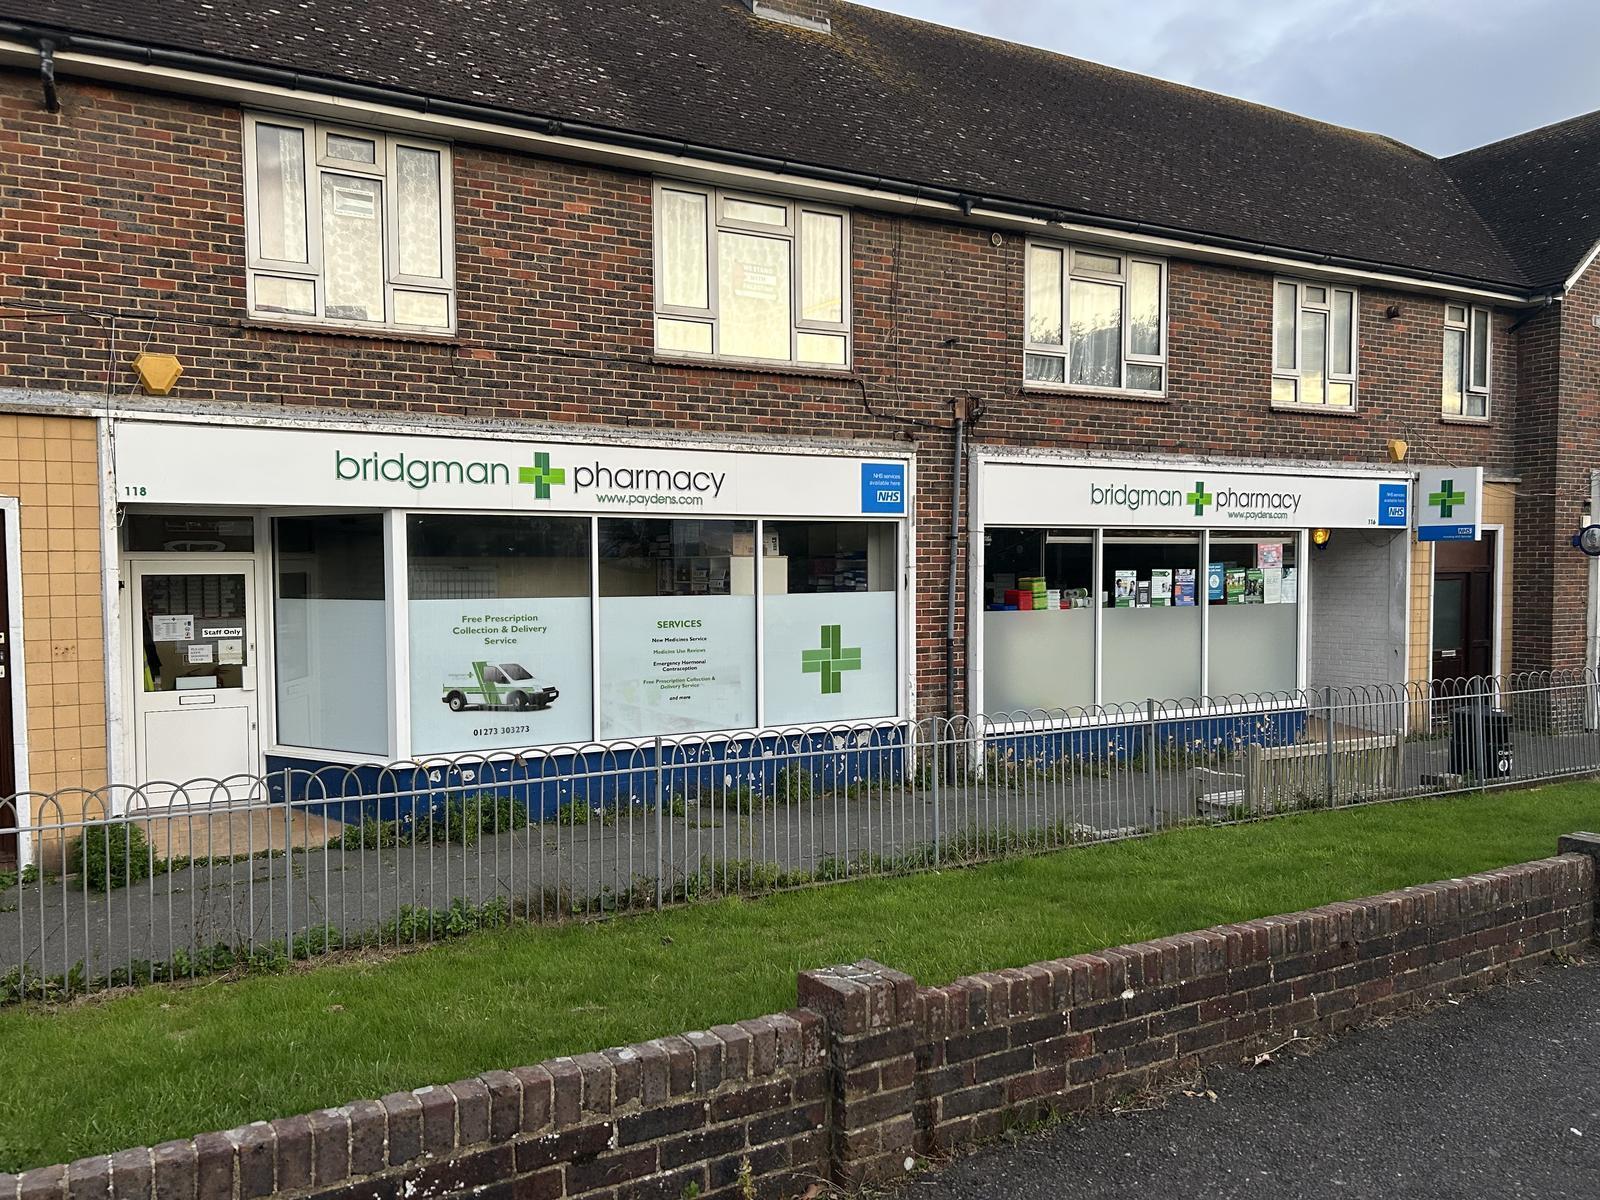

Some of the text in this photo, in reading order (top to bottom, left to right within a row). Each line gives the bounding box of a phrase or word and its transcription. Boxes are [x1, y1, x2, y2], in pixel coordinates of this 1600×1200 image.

[336, 450, 726, 498] bridgman pharmacy
[125, 486, 147, 496] 118
[596, 493, 703, 506] www.paydens.com
[878, 491, 900, 502] NHS
[1091, 483, 1301, 514] bridgman pharmacy
[1228, 511, 1288, 520] www.paydens.com
[1389, 507, 1403, 517] NHS
[462, 614, 538, 624] Free Prescription
[657, 620, 702, 628] SERVICES
[452, 626, 499, 635] Collection
[511, 625, 547, 634] Delivery
[484, 637, 517, 645] Service
[473, 725, 530, 736] 01273 303273
